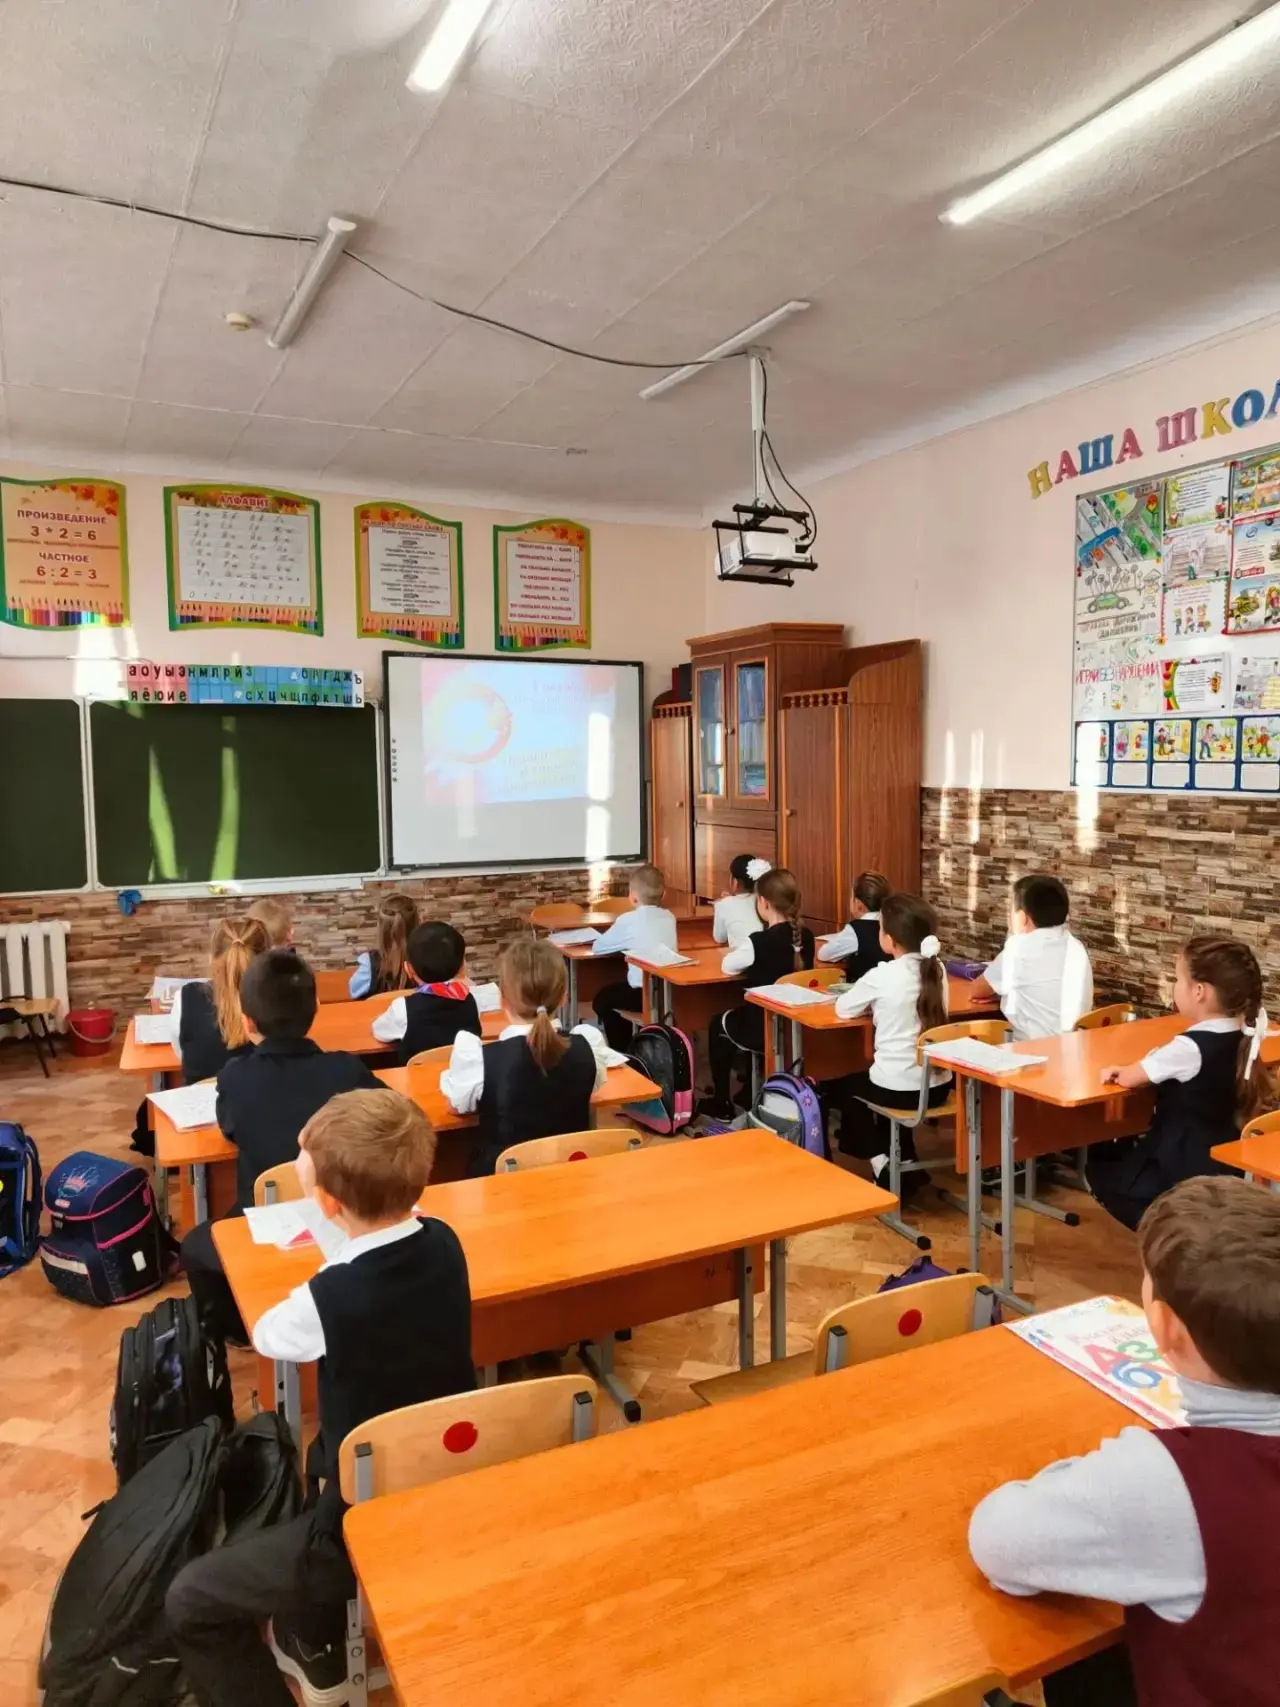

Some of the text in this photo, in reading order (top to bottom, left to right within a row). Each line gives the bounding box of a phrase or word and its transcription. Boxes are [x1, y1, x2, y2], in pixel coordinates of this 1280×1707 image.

[1027, 427, 1143, 499] НАША
[17, 509, 107, 524] ПРОИЗВЕДЕНИЕ
[30, 526, 40, 537] 3
[59, 528, 68, 539] 2
[87, 530, 97, 540] 6
[39, 552, 90, 563] ЧАСТНОЕ
[36, 566, 46, 576] 6
[60, 567, 69, 578] 2
[88, 569, 97, 579] 3
